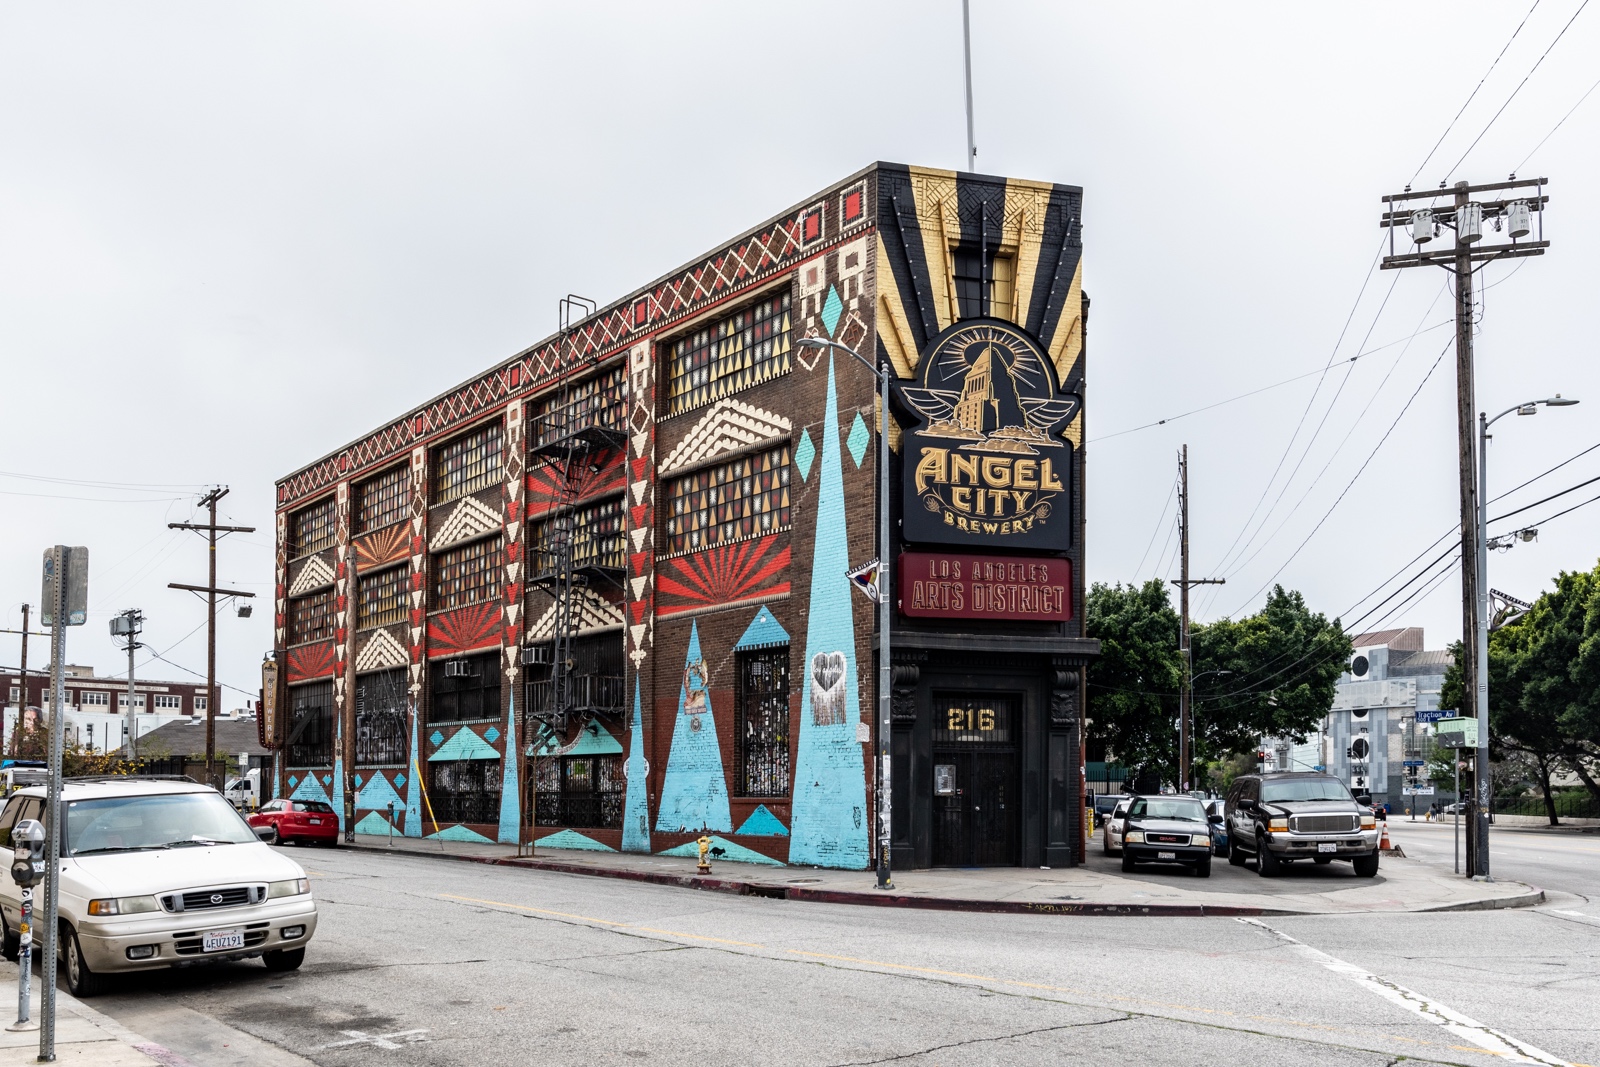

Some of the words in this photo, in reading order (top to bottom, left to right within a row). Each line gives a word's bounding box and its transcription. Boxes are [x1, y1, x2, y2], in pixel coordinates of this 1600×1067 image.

[915, 446, 1065, 496] ANGEL
[951, 486, 1033, 516] CITY
[944, 510, 1036, 535] BREWERY
[929, 559, 961, 580] LOS
[972, 561, 1048, 583] ANGELES
[911, 581, 965, 611] ARTS
[971, 583, 1065, 614] DISTRICT
[266, 683, 274, 740] BREWERY
[947, 708, 995, 731] 216
